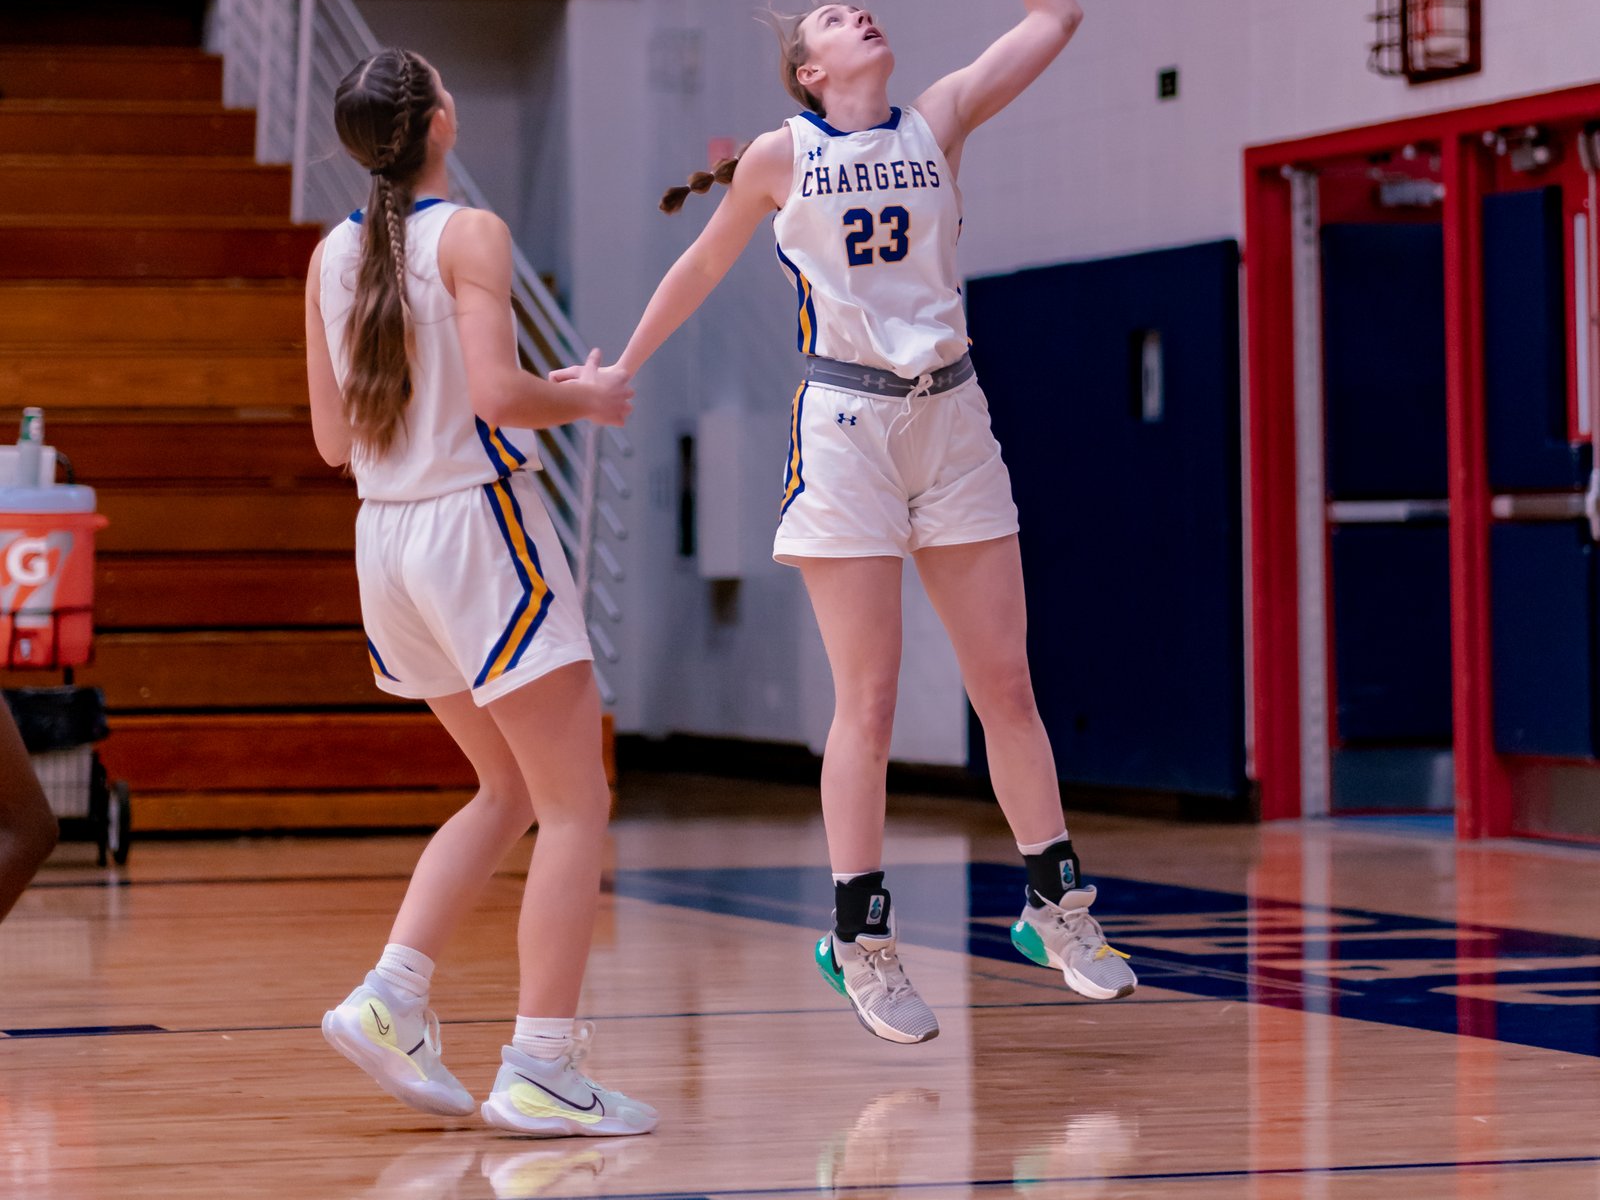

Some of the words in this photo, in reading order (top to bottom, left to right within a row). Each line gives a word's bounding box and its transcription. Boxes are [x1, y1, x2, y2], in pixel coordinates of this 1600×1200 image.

[801, 160, 940, 197] CHARGERS
[842, 204, 911, 267] 23
[6, 537, 49, 586] G
